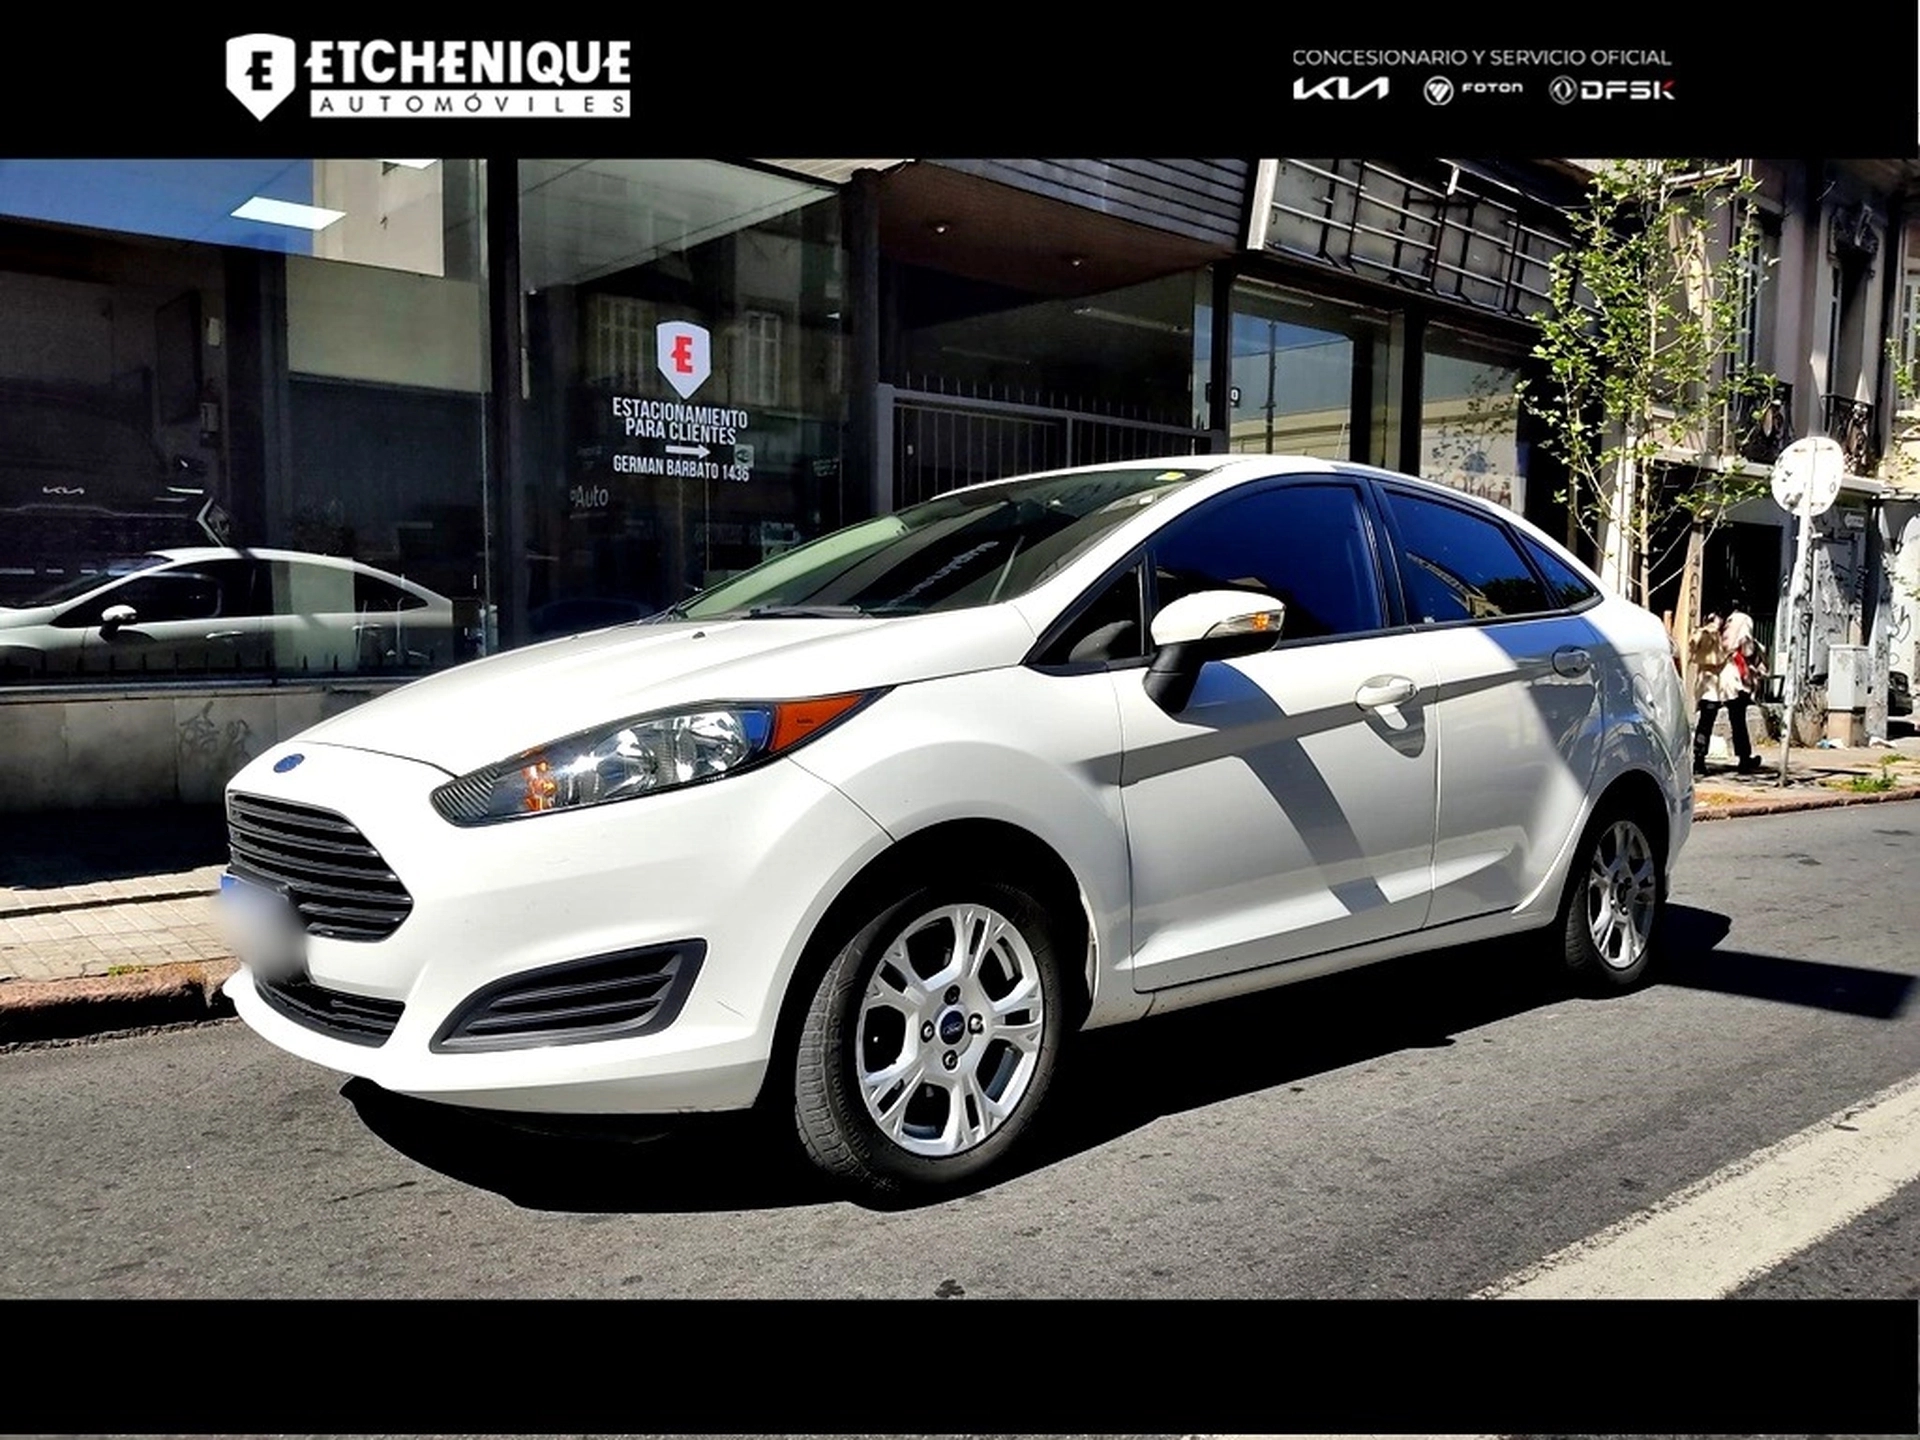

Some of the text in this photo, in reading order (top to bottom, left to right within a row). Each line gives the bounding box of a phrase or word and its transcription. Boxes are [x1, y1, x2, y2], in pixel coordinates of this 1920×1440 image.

[612, 397, 748, 429] ESTACIONAMIENTO
[625, 417, 736, 445] PARA CLIENTES
[613, 454, 750, 482] GERMAN BARBATO 1436
